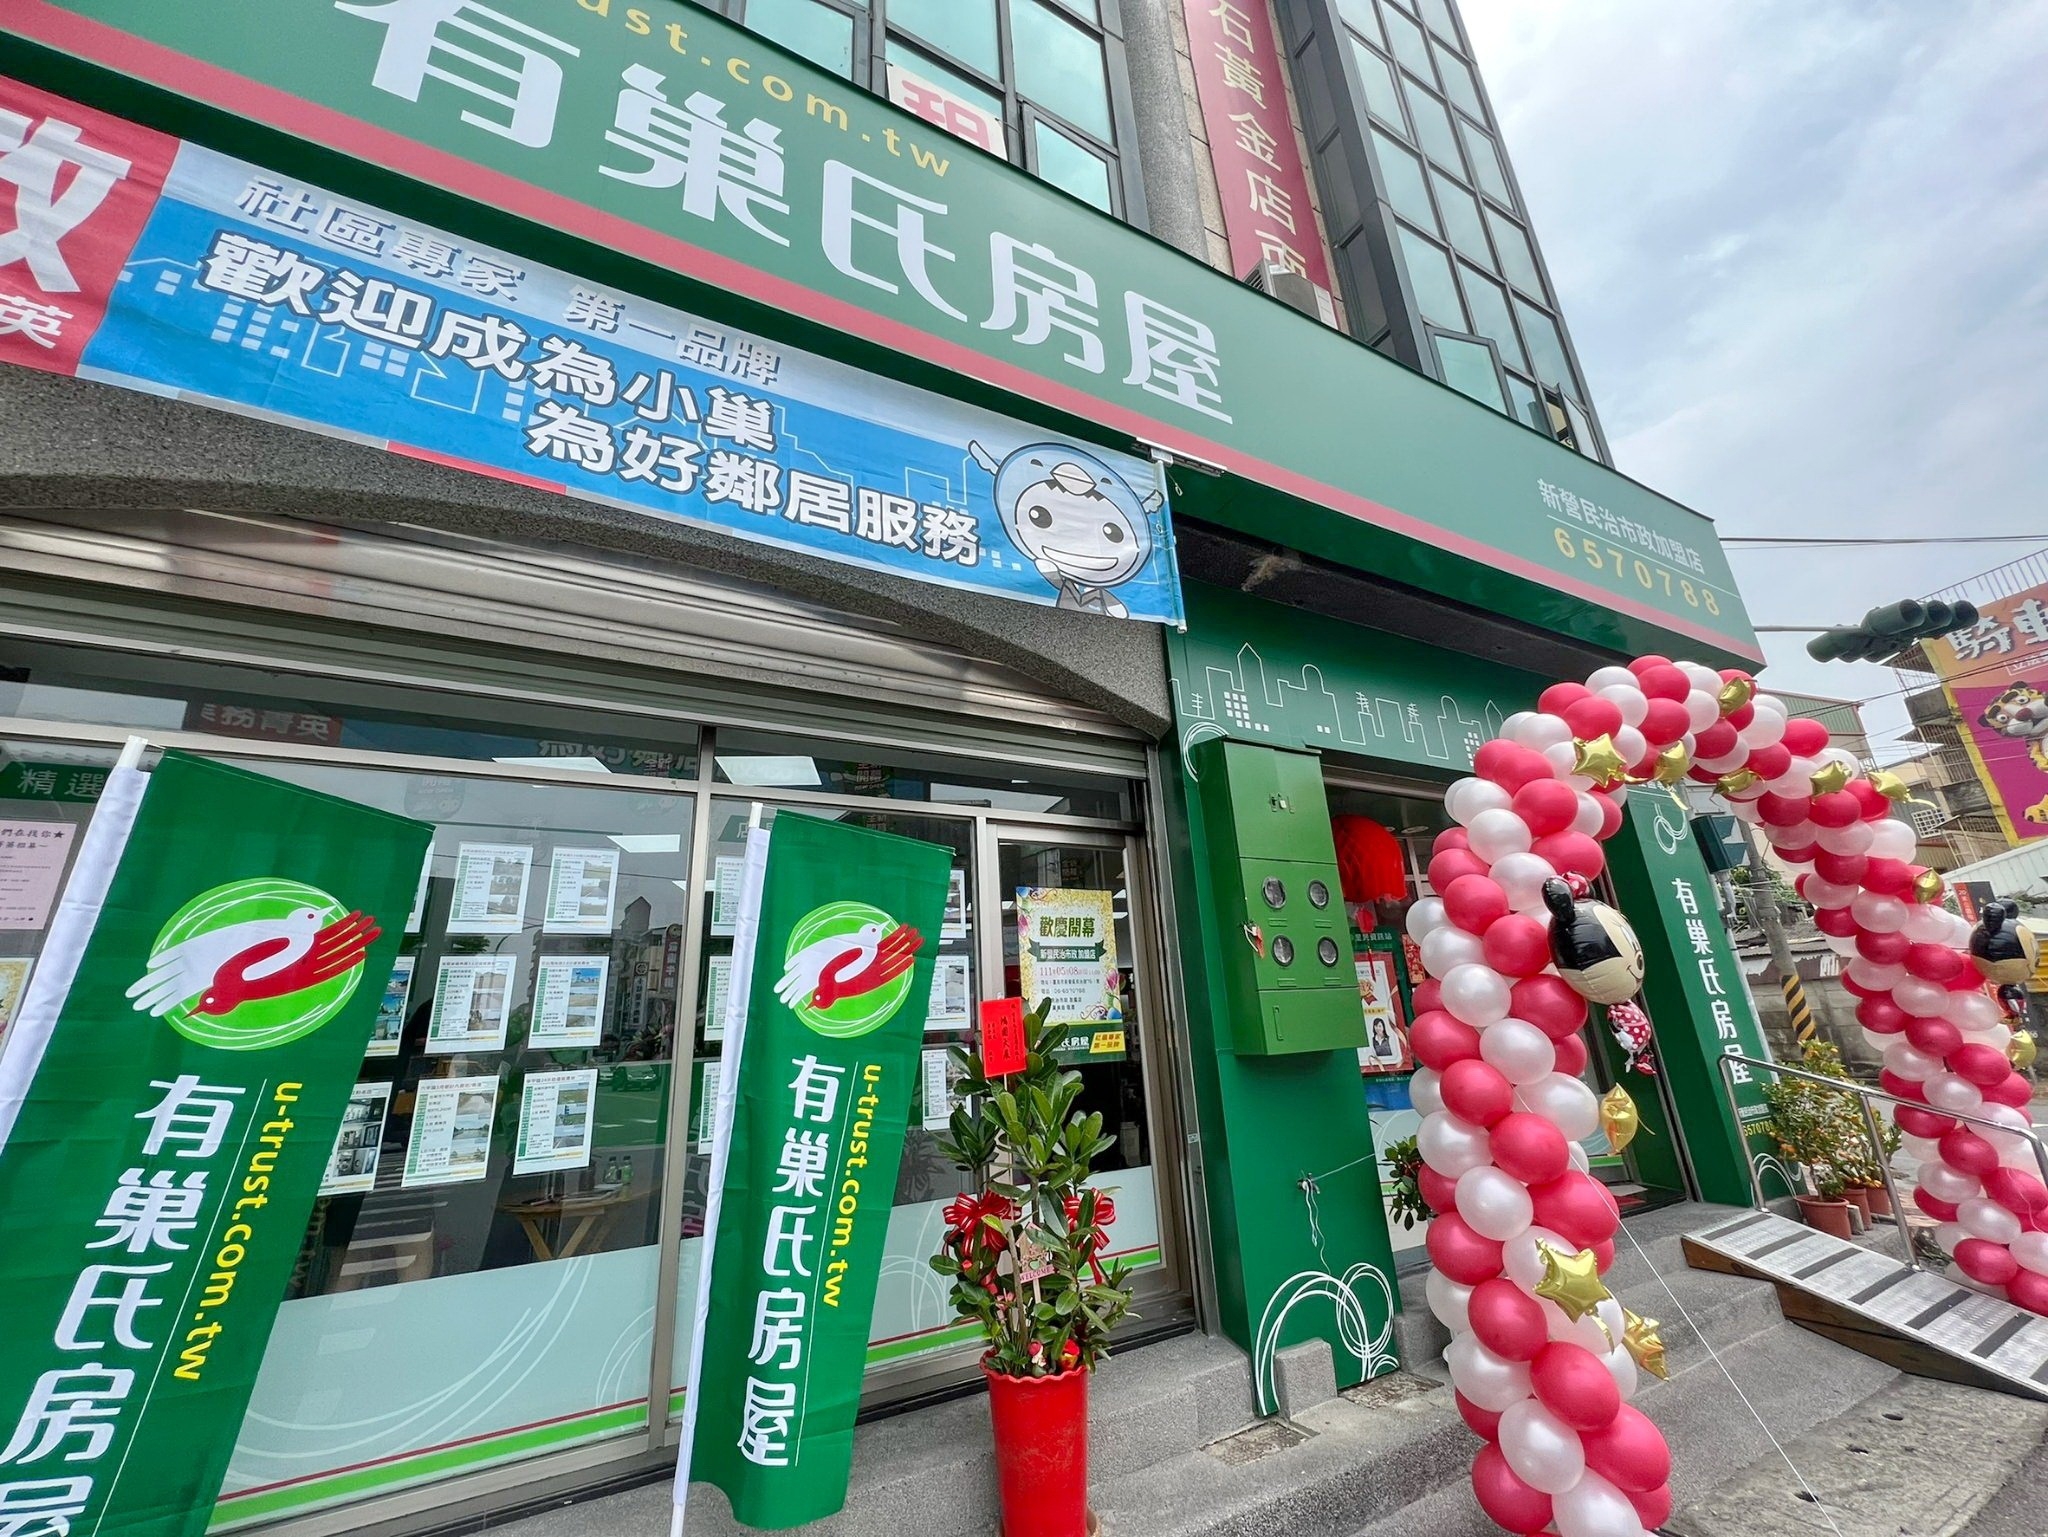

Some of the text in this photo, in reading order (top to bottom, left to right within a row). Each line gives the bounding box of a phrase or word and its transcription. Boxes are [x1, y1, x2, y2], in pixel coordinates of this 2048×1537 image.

[235, 173, 526, 302] 社區專家
[561, 283, 781, 385] 第一品牌
[335, 0, 1233, 424] 有巢氏房屋
[198, 230, 778, 454] 歡迎成為小巢
[524, 398, 982, 568] 為好鄰居服務
[1537, 477, 1705, 575] 新營民治市政加盟店
[1554, 527, 1720, 617] 6570788
[1040, 916, 1095, 938] 歡慶開幕
[1672, 877, 1753, 1085] 有巢氏房屋
[173, 1081, 303, 1382] u-trust.com.tw
[736, 1053, 846, 1468] 有巢氏房屋
[822, 1063, 882, 1308] u-trust.com.tw
